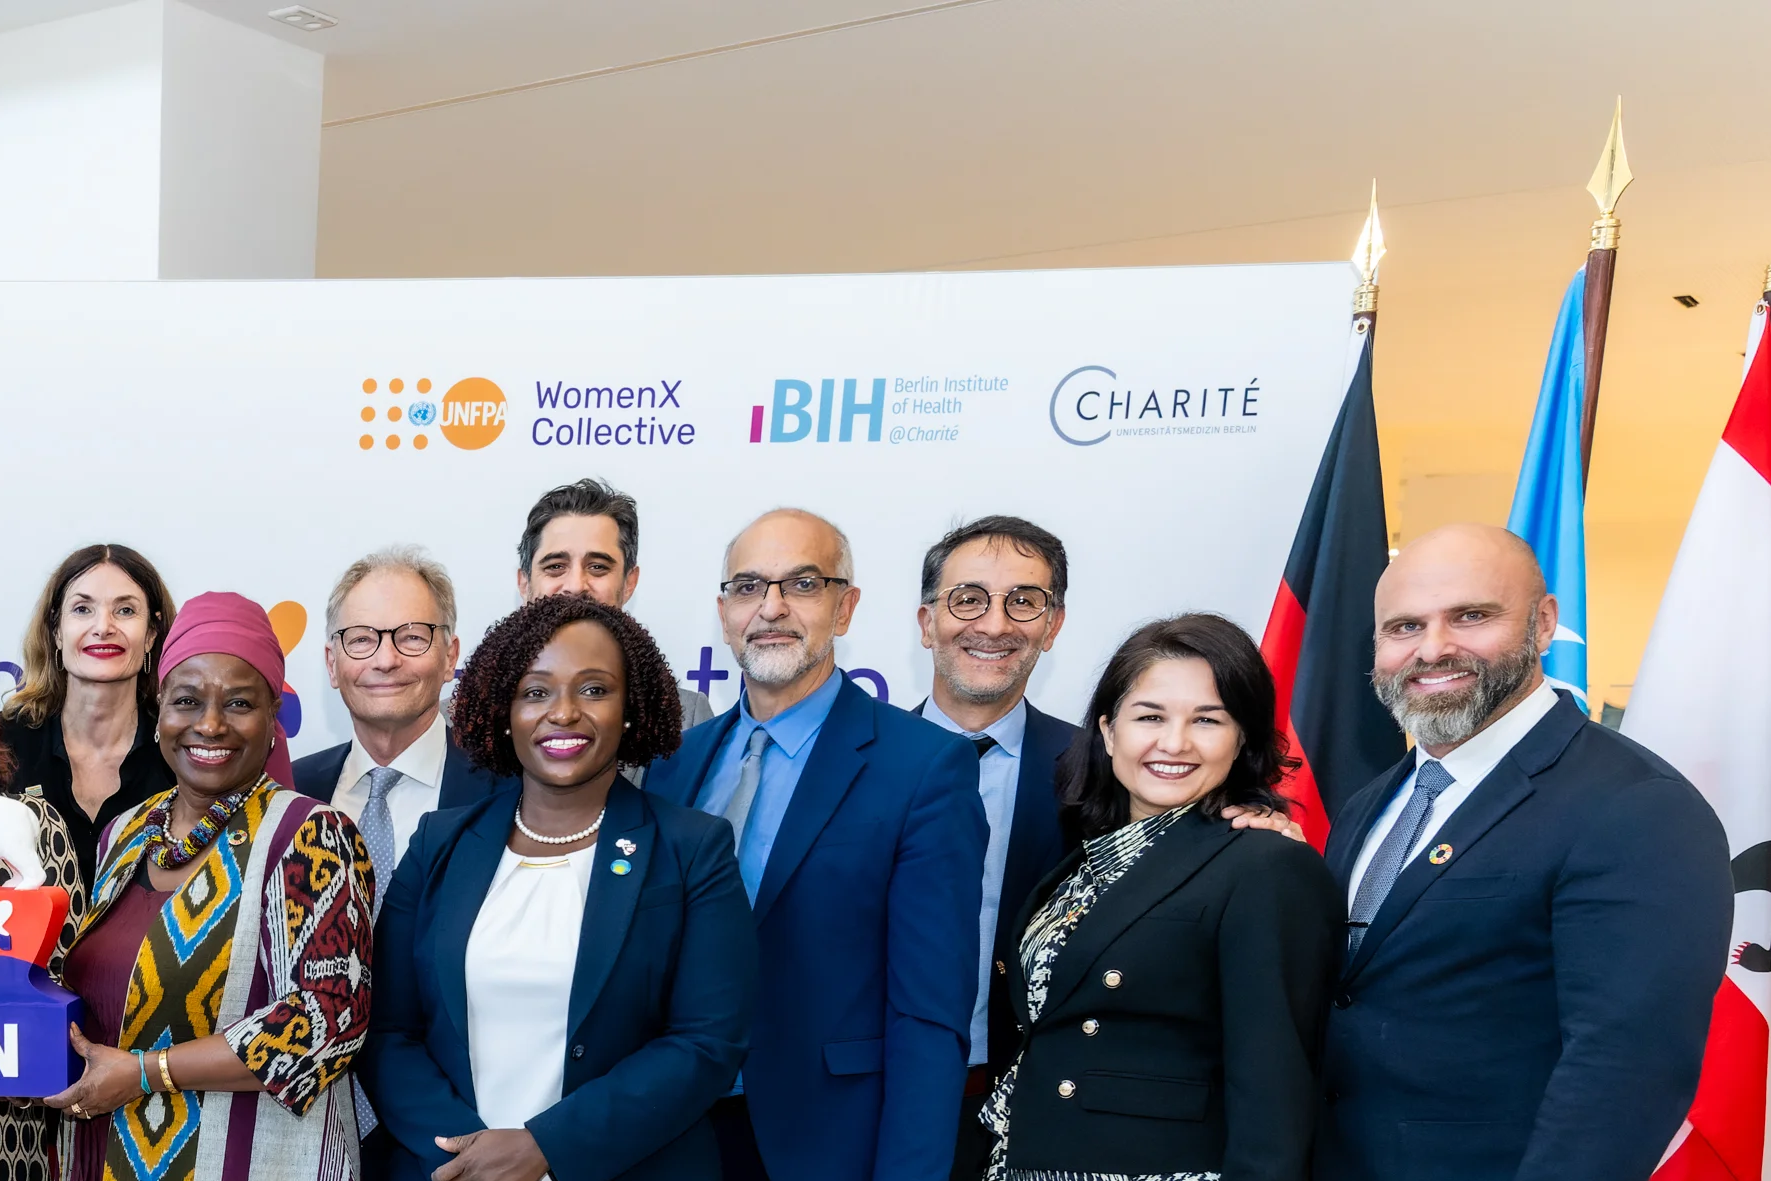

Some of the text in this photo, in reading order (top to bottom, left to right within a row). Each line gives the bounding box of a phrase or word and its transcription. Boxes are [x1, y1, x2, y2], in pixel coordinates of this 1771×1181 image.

[535, 379, 682, 409] WomenX
[894, 374, 1009, 393] Berlin Institute
[892, 397, 962, 415] of Health
[1076, 377, 1260, 421] CHARITÉ
[439, 400, 509, 427] UNFPA
[531, 416, 696, 446] Collective
[1116, 425, 1257, 437] UNIVERSITÄTSMEDIZIN BERLIN
